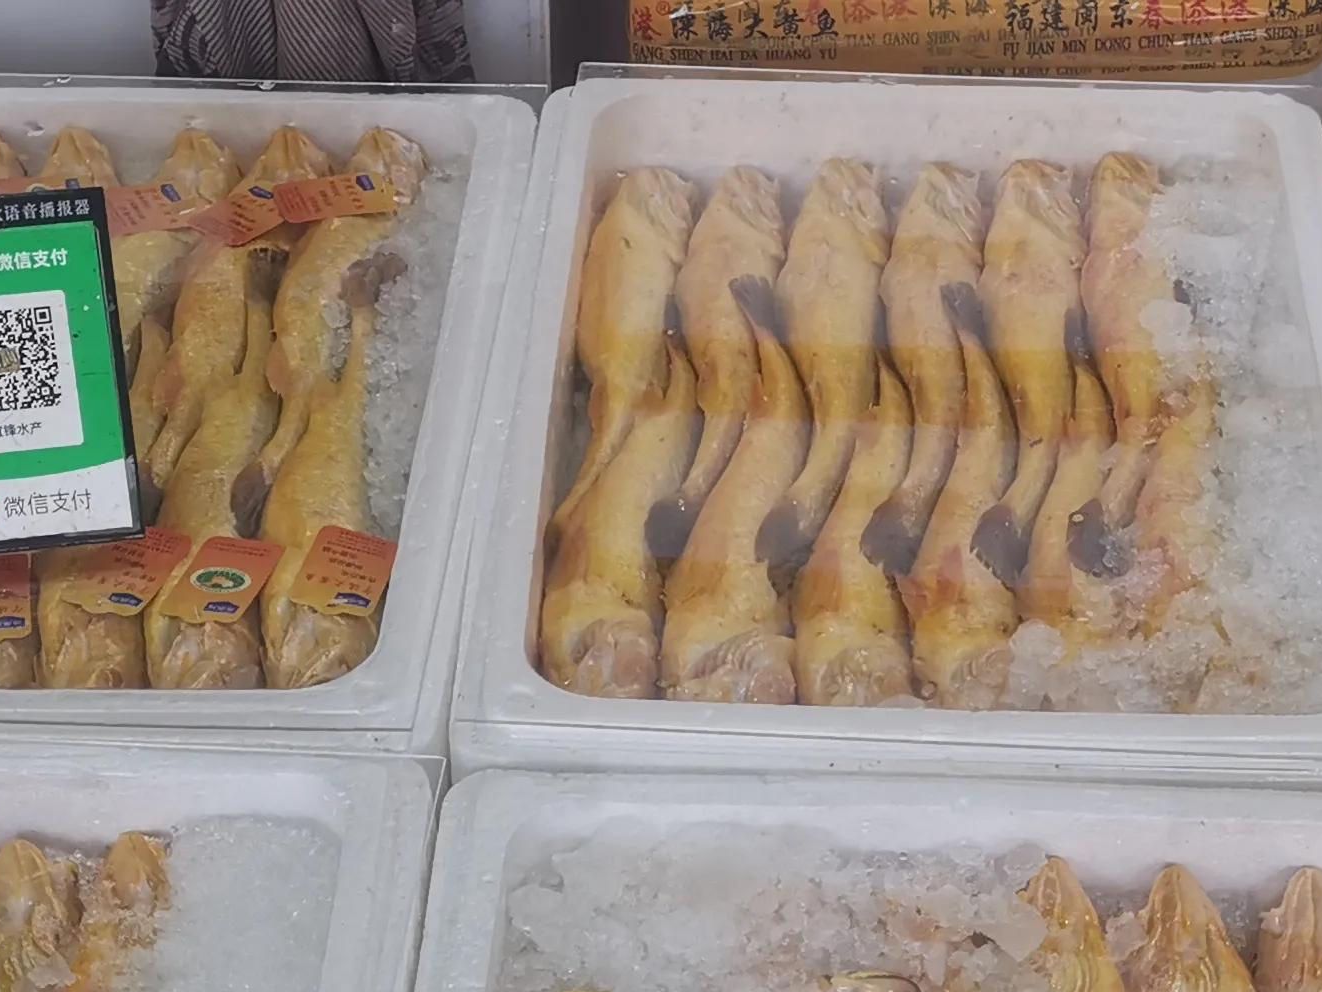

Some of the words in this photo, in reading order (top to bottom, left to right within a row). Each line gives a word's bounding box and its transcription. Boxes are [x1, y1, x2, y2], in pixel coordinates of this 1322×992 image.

[845, 33, 876, 47] TIAN
[884, 32, 919, 46] GANG
[1027, 41, 1055, 56] JIAN
[1062, 39, 1087, 54] MIN
[1095, 36, 1131, 51] DONG
[1138, 34, 1173, 49] CHUN
[670, 49, 703, 60] SHEN
[740, 49, 758, 61] DA
[766, 48, 811, 60] HUANG
[820, 48, 837, 60] YU
[3, 488, 91, 518] 微信支付
